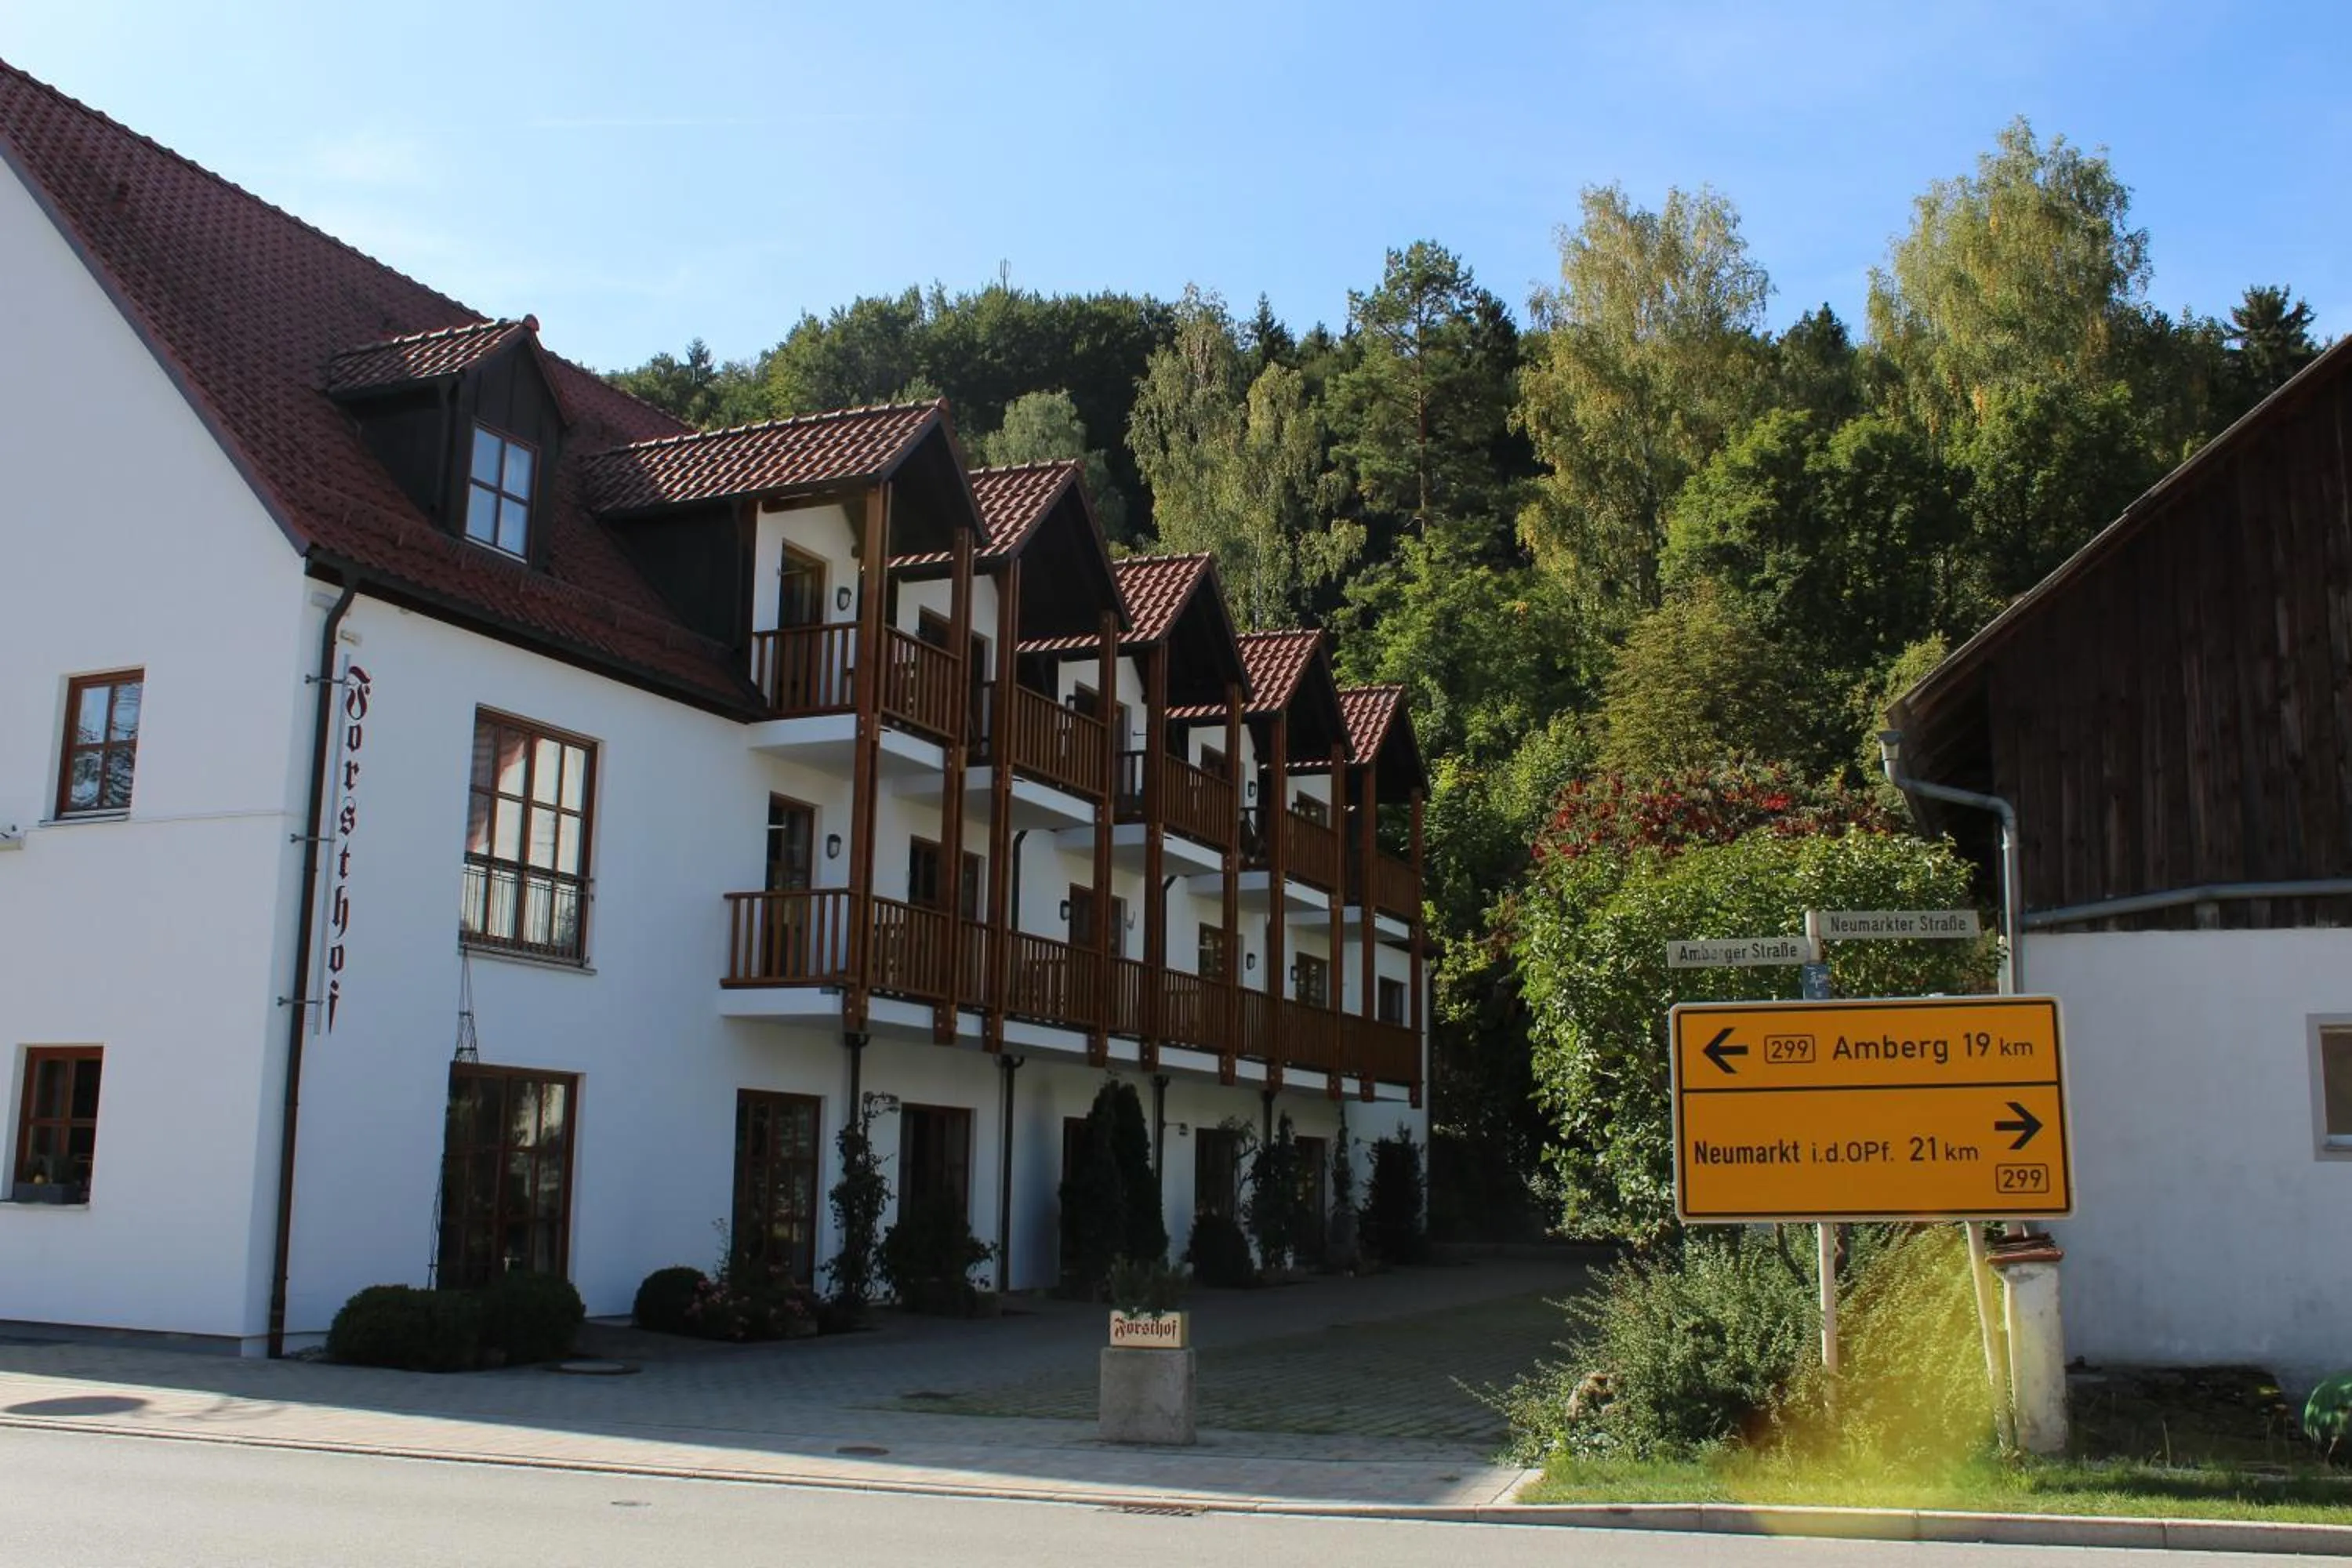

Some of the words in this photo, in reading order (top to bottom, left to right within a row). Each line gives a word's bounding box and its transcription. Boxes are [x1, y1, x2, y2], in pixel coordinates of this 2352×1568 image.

[328, 666, 372, 1034] Forsthof
[1830, 915, 1914, 933] Neumarkter
[1918, 915, 1967, 931] Straße
[1751, 942, 1798, 959] Straße
[1770, 1040, 1809, 1059] 299
[1832, 1035, 1949, 1064] Amberg
[1962, 1033, 1991, 1057] 19
[2000, 1038, 2034, 1057] km
[1693, 1140, 1800, 1165] Neumarkt
[1811, 1142, 1894, 1163] i.d.OPf.
[1908, 1137, 1937, 1162] 21
[1945, 1143, 1980, 1162] km
[2002, 1169, 2042, 1189] 299
[1114, 1316, 1178, 1340] Forsthof
